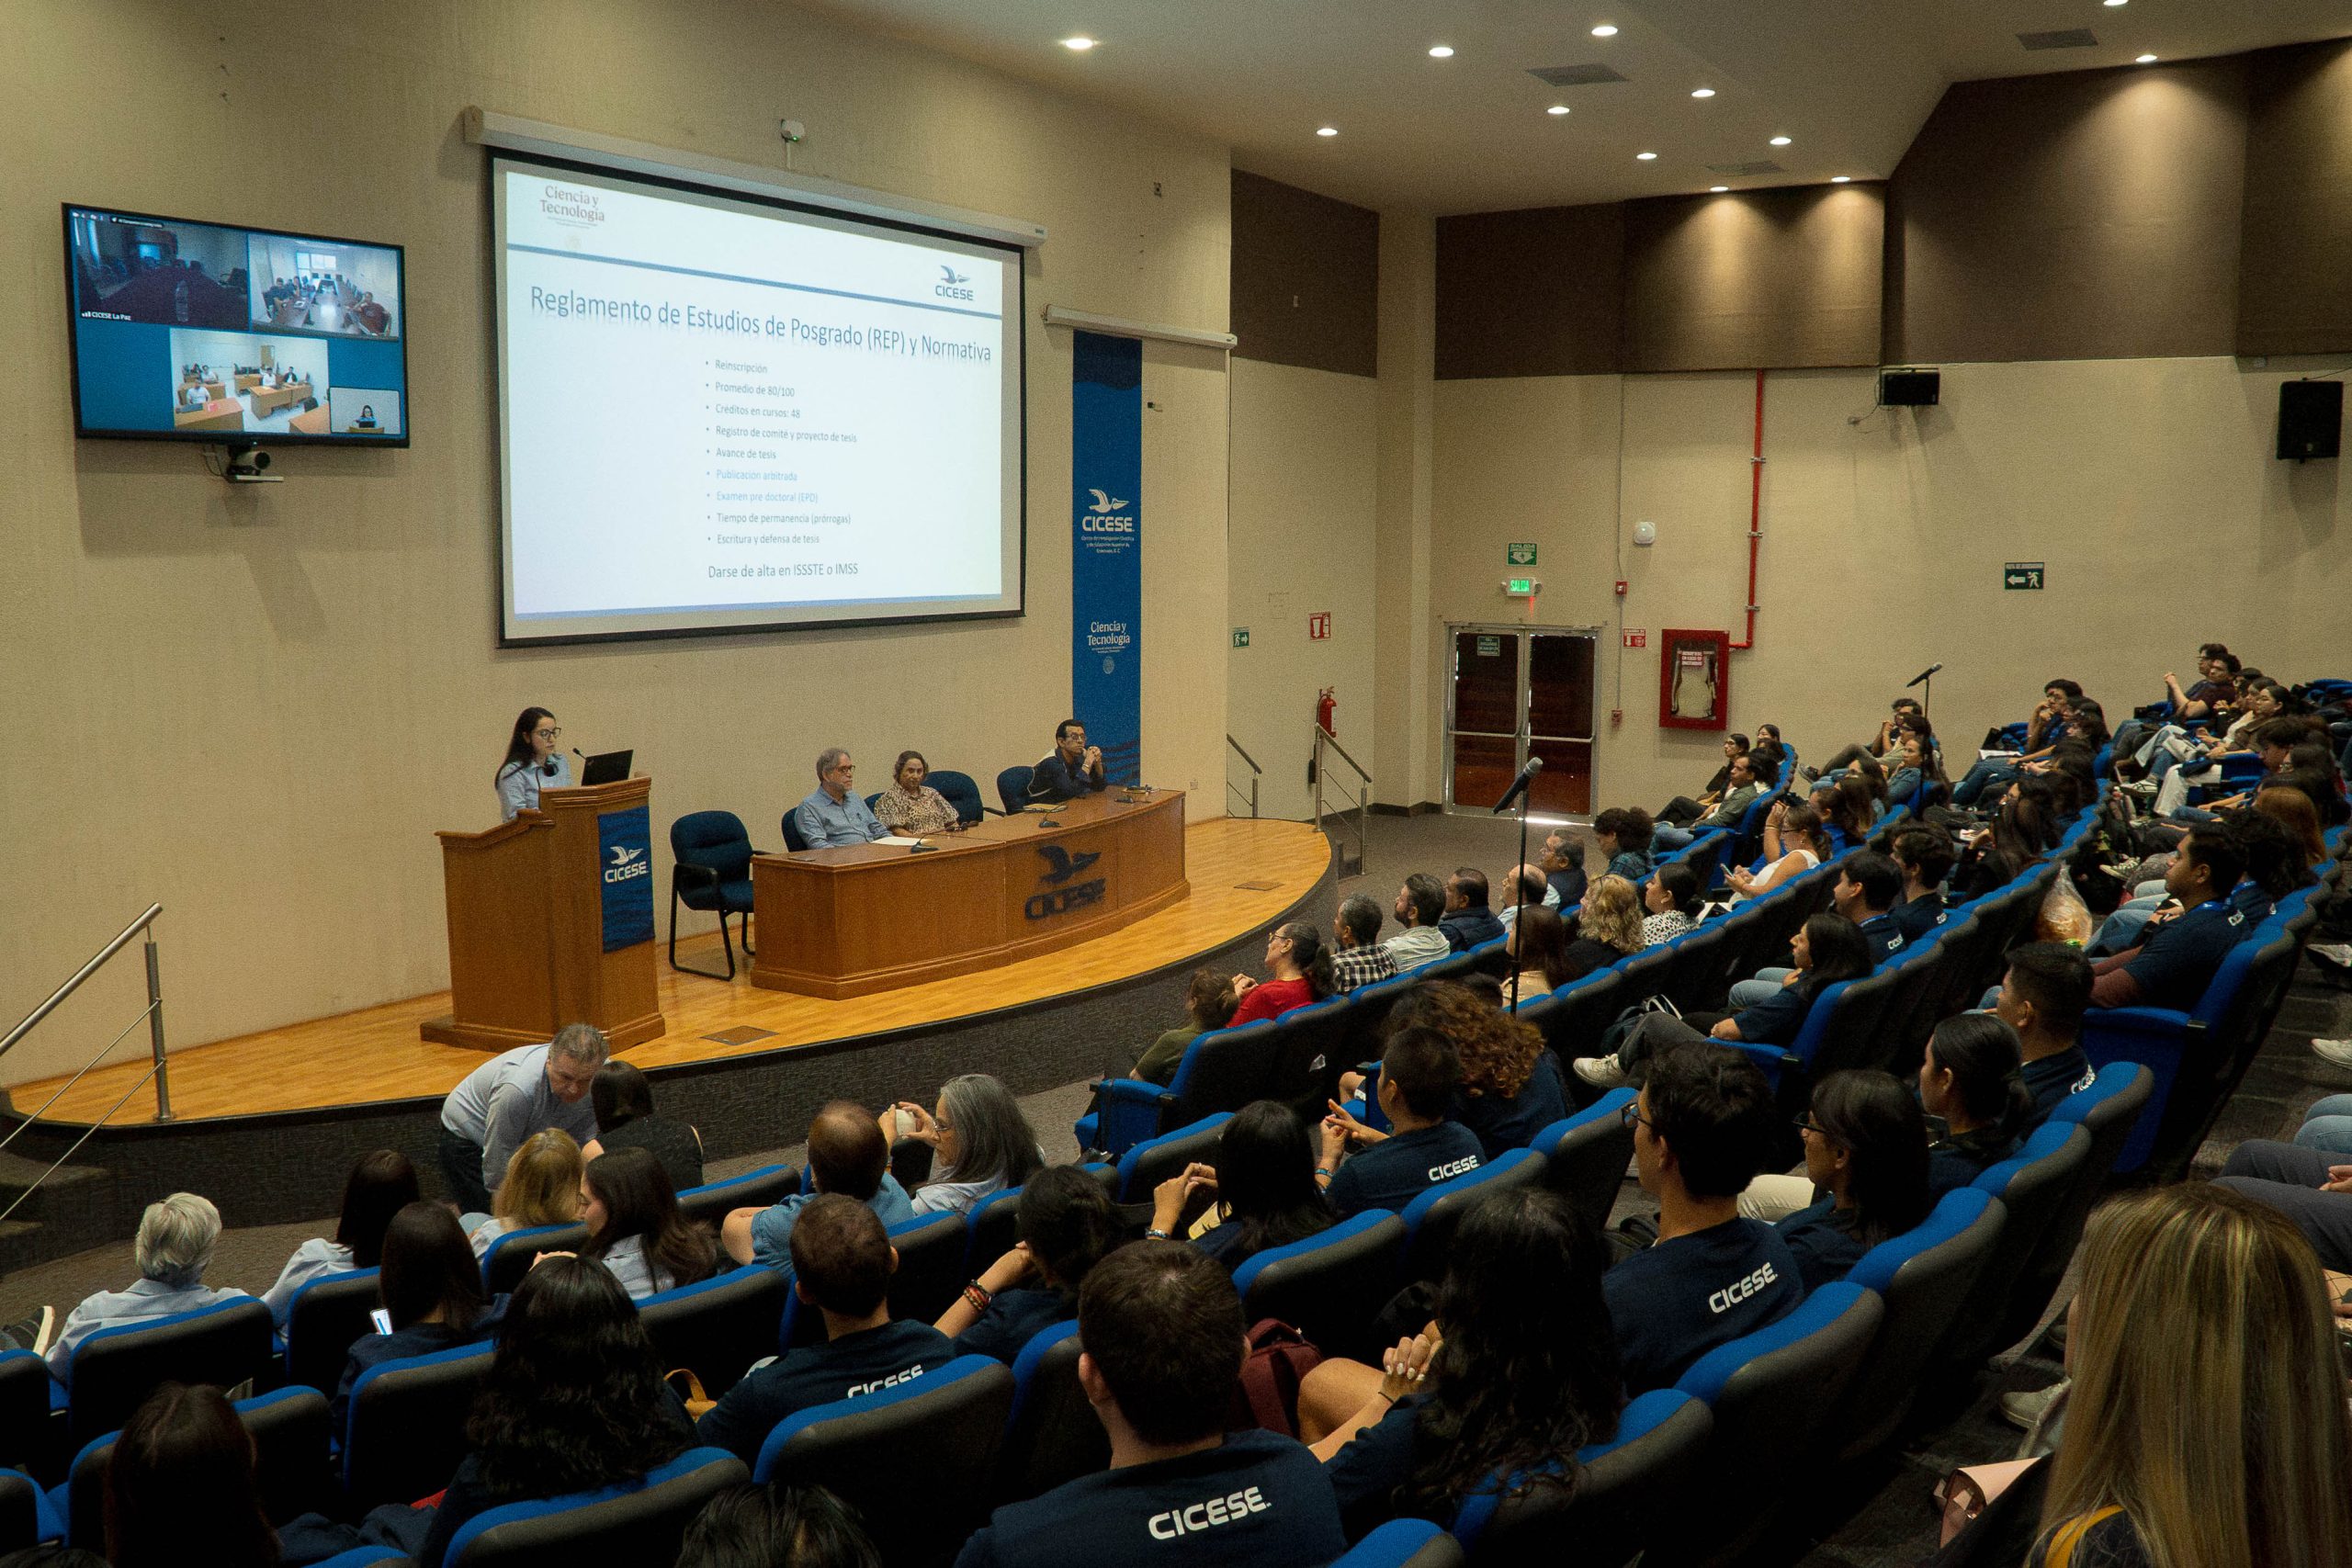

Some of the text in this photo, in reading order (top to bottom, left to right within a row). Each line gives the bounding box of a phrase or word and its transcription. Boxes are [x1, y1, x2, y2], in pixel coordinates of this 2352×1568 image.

[545, 186, 599, 208] Ciencia y
[935, 284, 974, 301] CICESE
[531, 286, 991, 361] Reglamento de Estudios de Posgrado (REP) y Normativa
[716, 381, 795, 398] Promedio de 80/100
[716, 403, 749, 416] Créditos
[751, 407, 761, 416] en
[763, 408, 789, 418] cursos:
[716, 425, 857, 443] Registro de comité y proyecto de tesis
[716, 447, 776, 459] Avance de tesis
[763, 470, 797, 481] arbitrada
[717, 491, 819, 504] Examen pre doctoral (EPD)
[717, 513, 747, 525] Tiempo
[749, 513, 759, 524] de
[761, 513, 809, 525] permanencia
[1081, 515, 1133, 532] CICESE
[717, 534, 820, 546] Escritura y defensa de tesis
[708, 562, 858, 579] Darse de alta en ISSSTE o IMSS
[1091, 620, 1126, 634] Ciencia y
[1087, 632, 1130, 646] Tecnología
[605, 861, 647, 883] CICESE
[1428, 1155, 1478, 1181] CICESE
[1709, 1261, 1776, 1314] CICESE
[1148, 1485, 1268, 1540] CICESE
